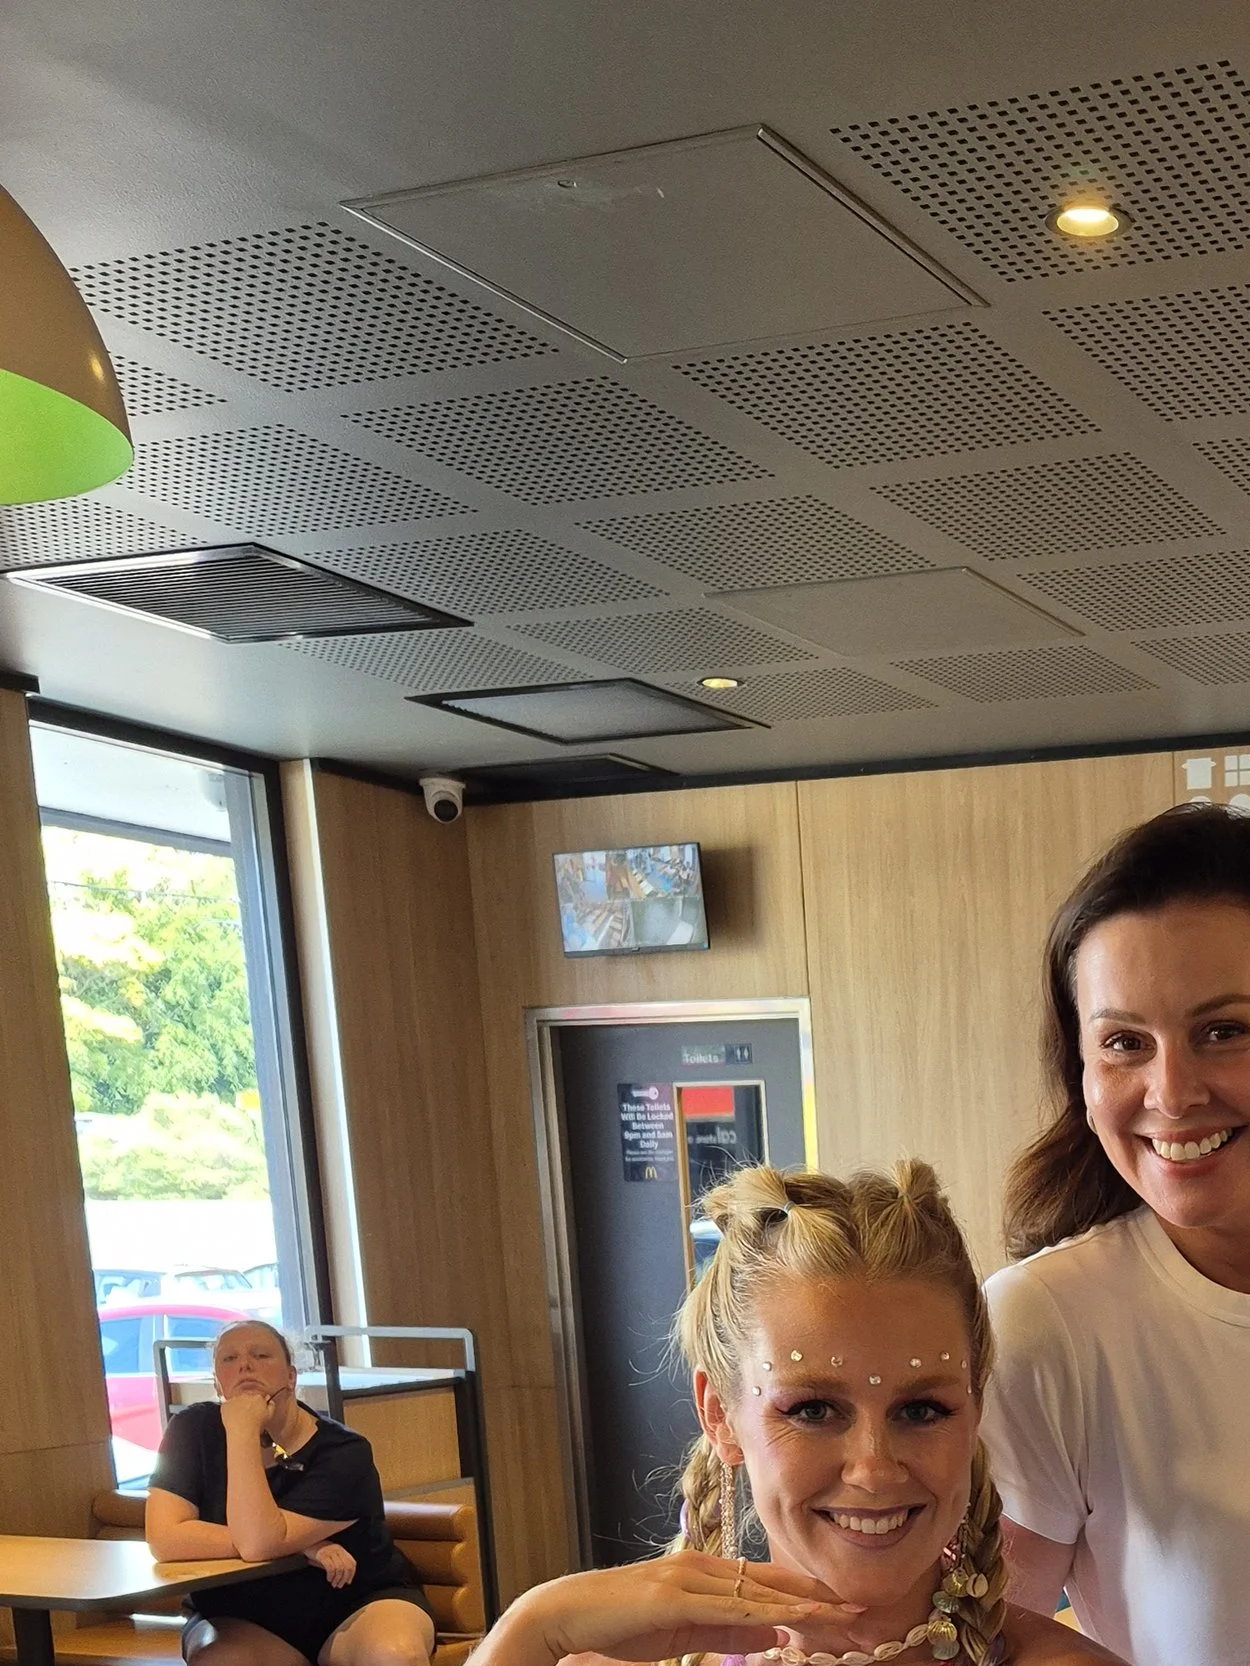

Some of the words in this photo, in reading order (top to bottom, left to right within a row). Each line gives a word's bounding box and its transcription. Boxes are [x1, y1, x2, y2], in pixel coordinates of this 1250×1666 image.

[683, 1053, 719, 1064] Toilets
[623, 1104, 645, 1112] These
[646, 1103, 671, 1111] Toilets
[620, 1113, 635, 1121] Will
[636, 1112, 646, 1120] Be
[647, 1111, 674, 1120] Locked
[632, 1122, 664, 1130] Between
[642, 1131, 656, 1139] and
[639, 1140, 659, 1150] Daily
